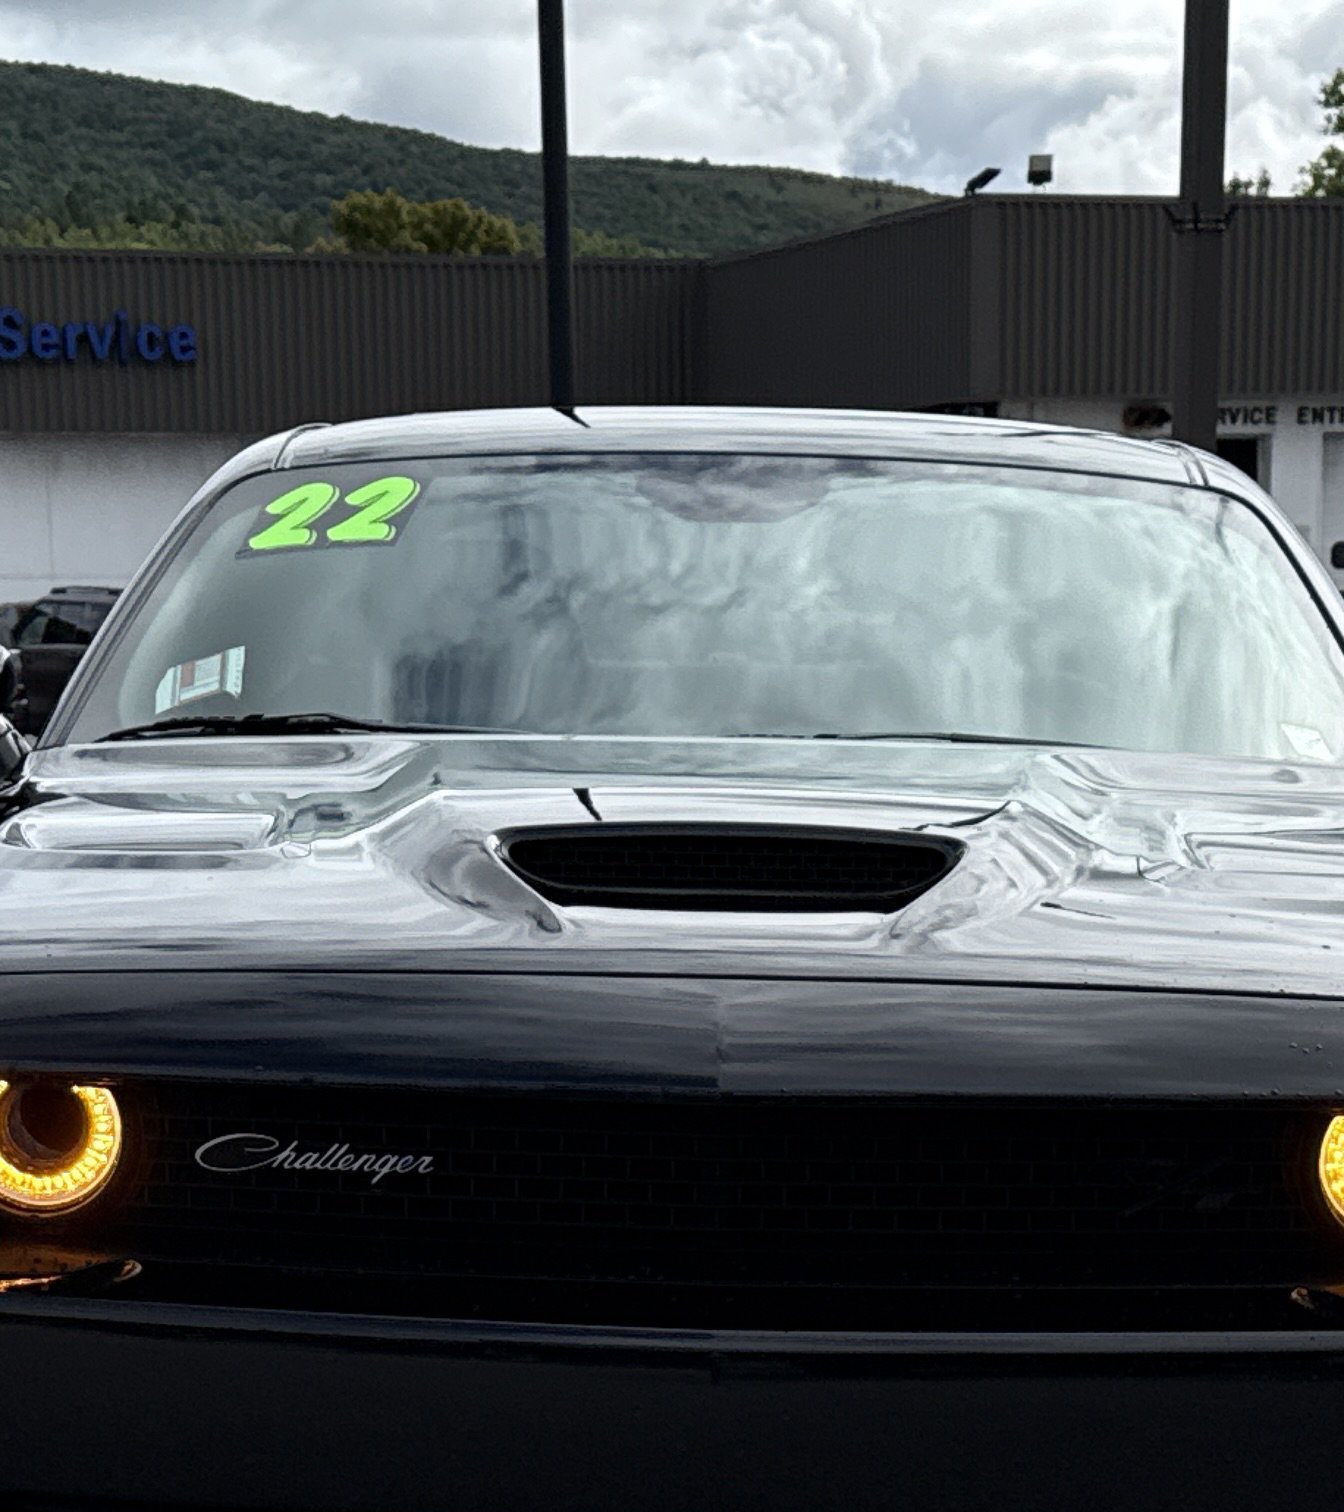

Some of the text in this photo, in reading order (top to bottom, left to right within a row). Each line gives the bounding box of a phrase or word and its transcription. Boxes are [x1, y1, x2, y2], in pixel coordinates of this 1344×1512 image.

[1217, 406, 1278, 426] RVICE
[248, 476, 421, 551] 22
[194, 1133, 435, 1185] Challenger
